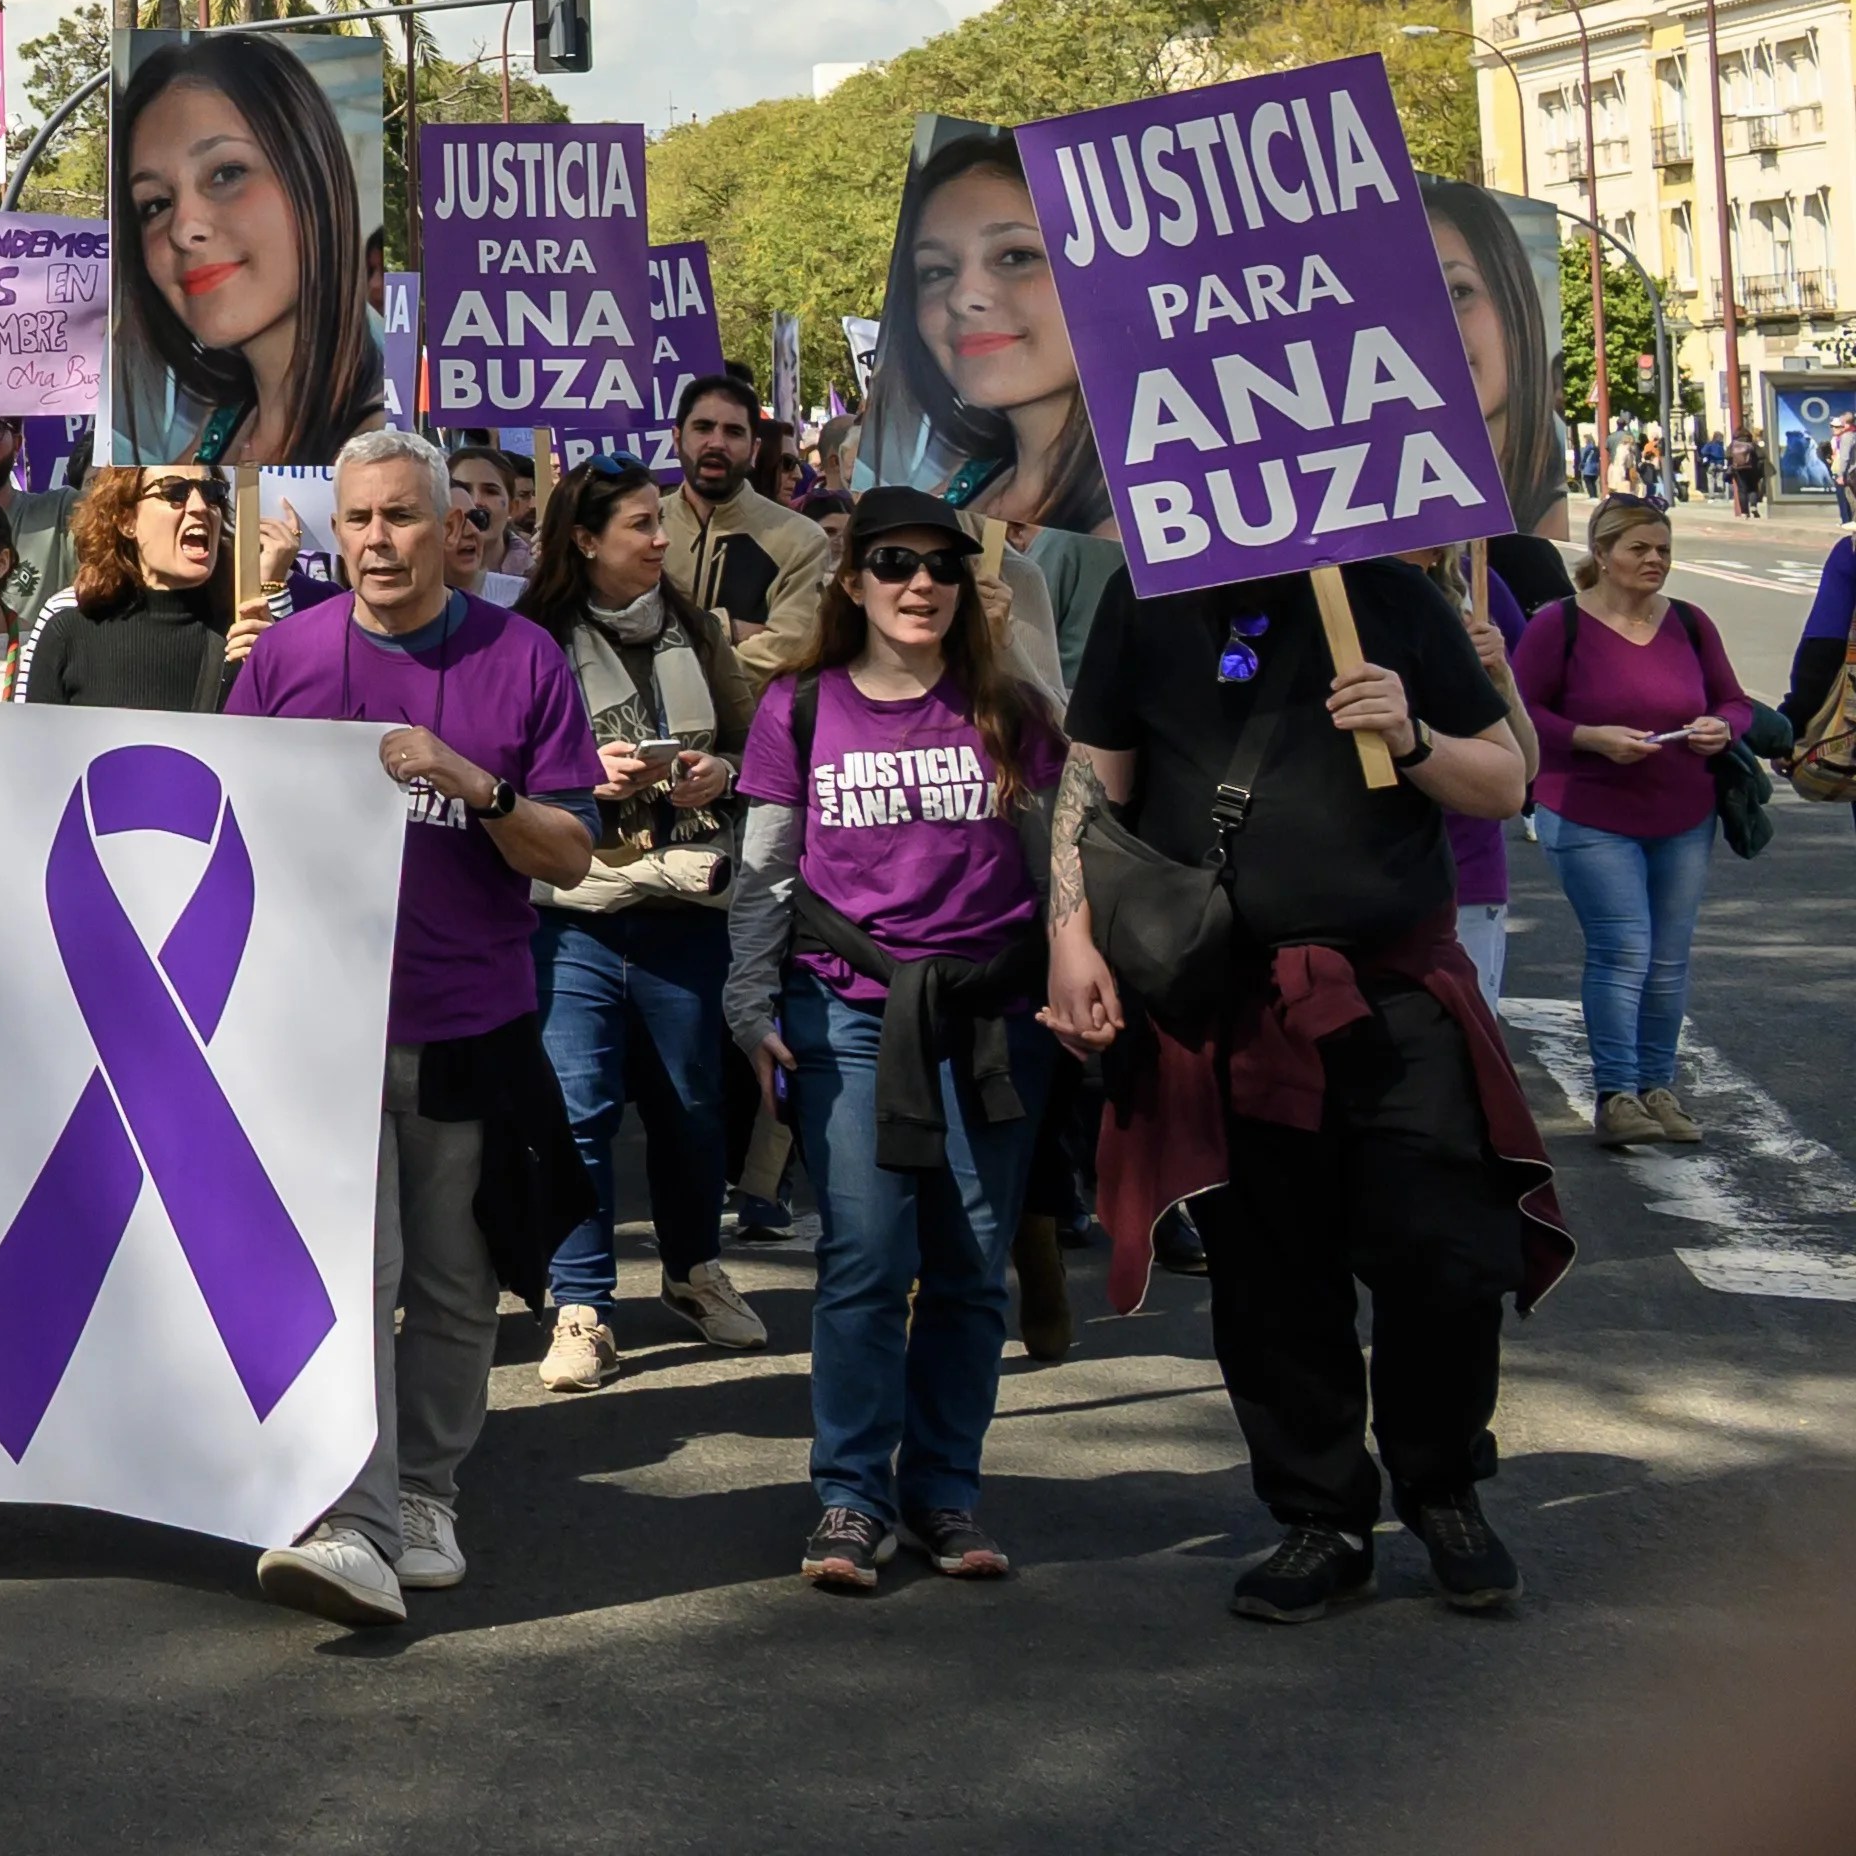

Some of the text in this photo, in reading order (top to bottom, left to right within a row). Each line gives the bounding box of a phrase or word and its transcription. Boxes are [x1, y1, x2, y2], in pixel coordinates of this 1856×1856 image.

[435, 141, 636, 219] JUSTICIA
[1055, 90, 1399, 267] JUSTICIA
[46, 263, 98, 303] EN
[479, 240, 596, 273] PARA
[442, 291, 634, 346] ANA
[1148, 255, 1356, 341] PARA
[6, 361, 55, 390] Ana
[440, 359, 643, 409] BUZA
[1125, 324, 1448, 466] ANA
[1127, 431, 1486, 564] BUZA
[814, 764, 842, 827] PARA
[837, 746, 984, 790] JUSTICIA
[842, 788, 912, 828] ANA
